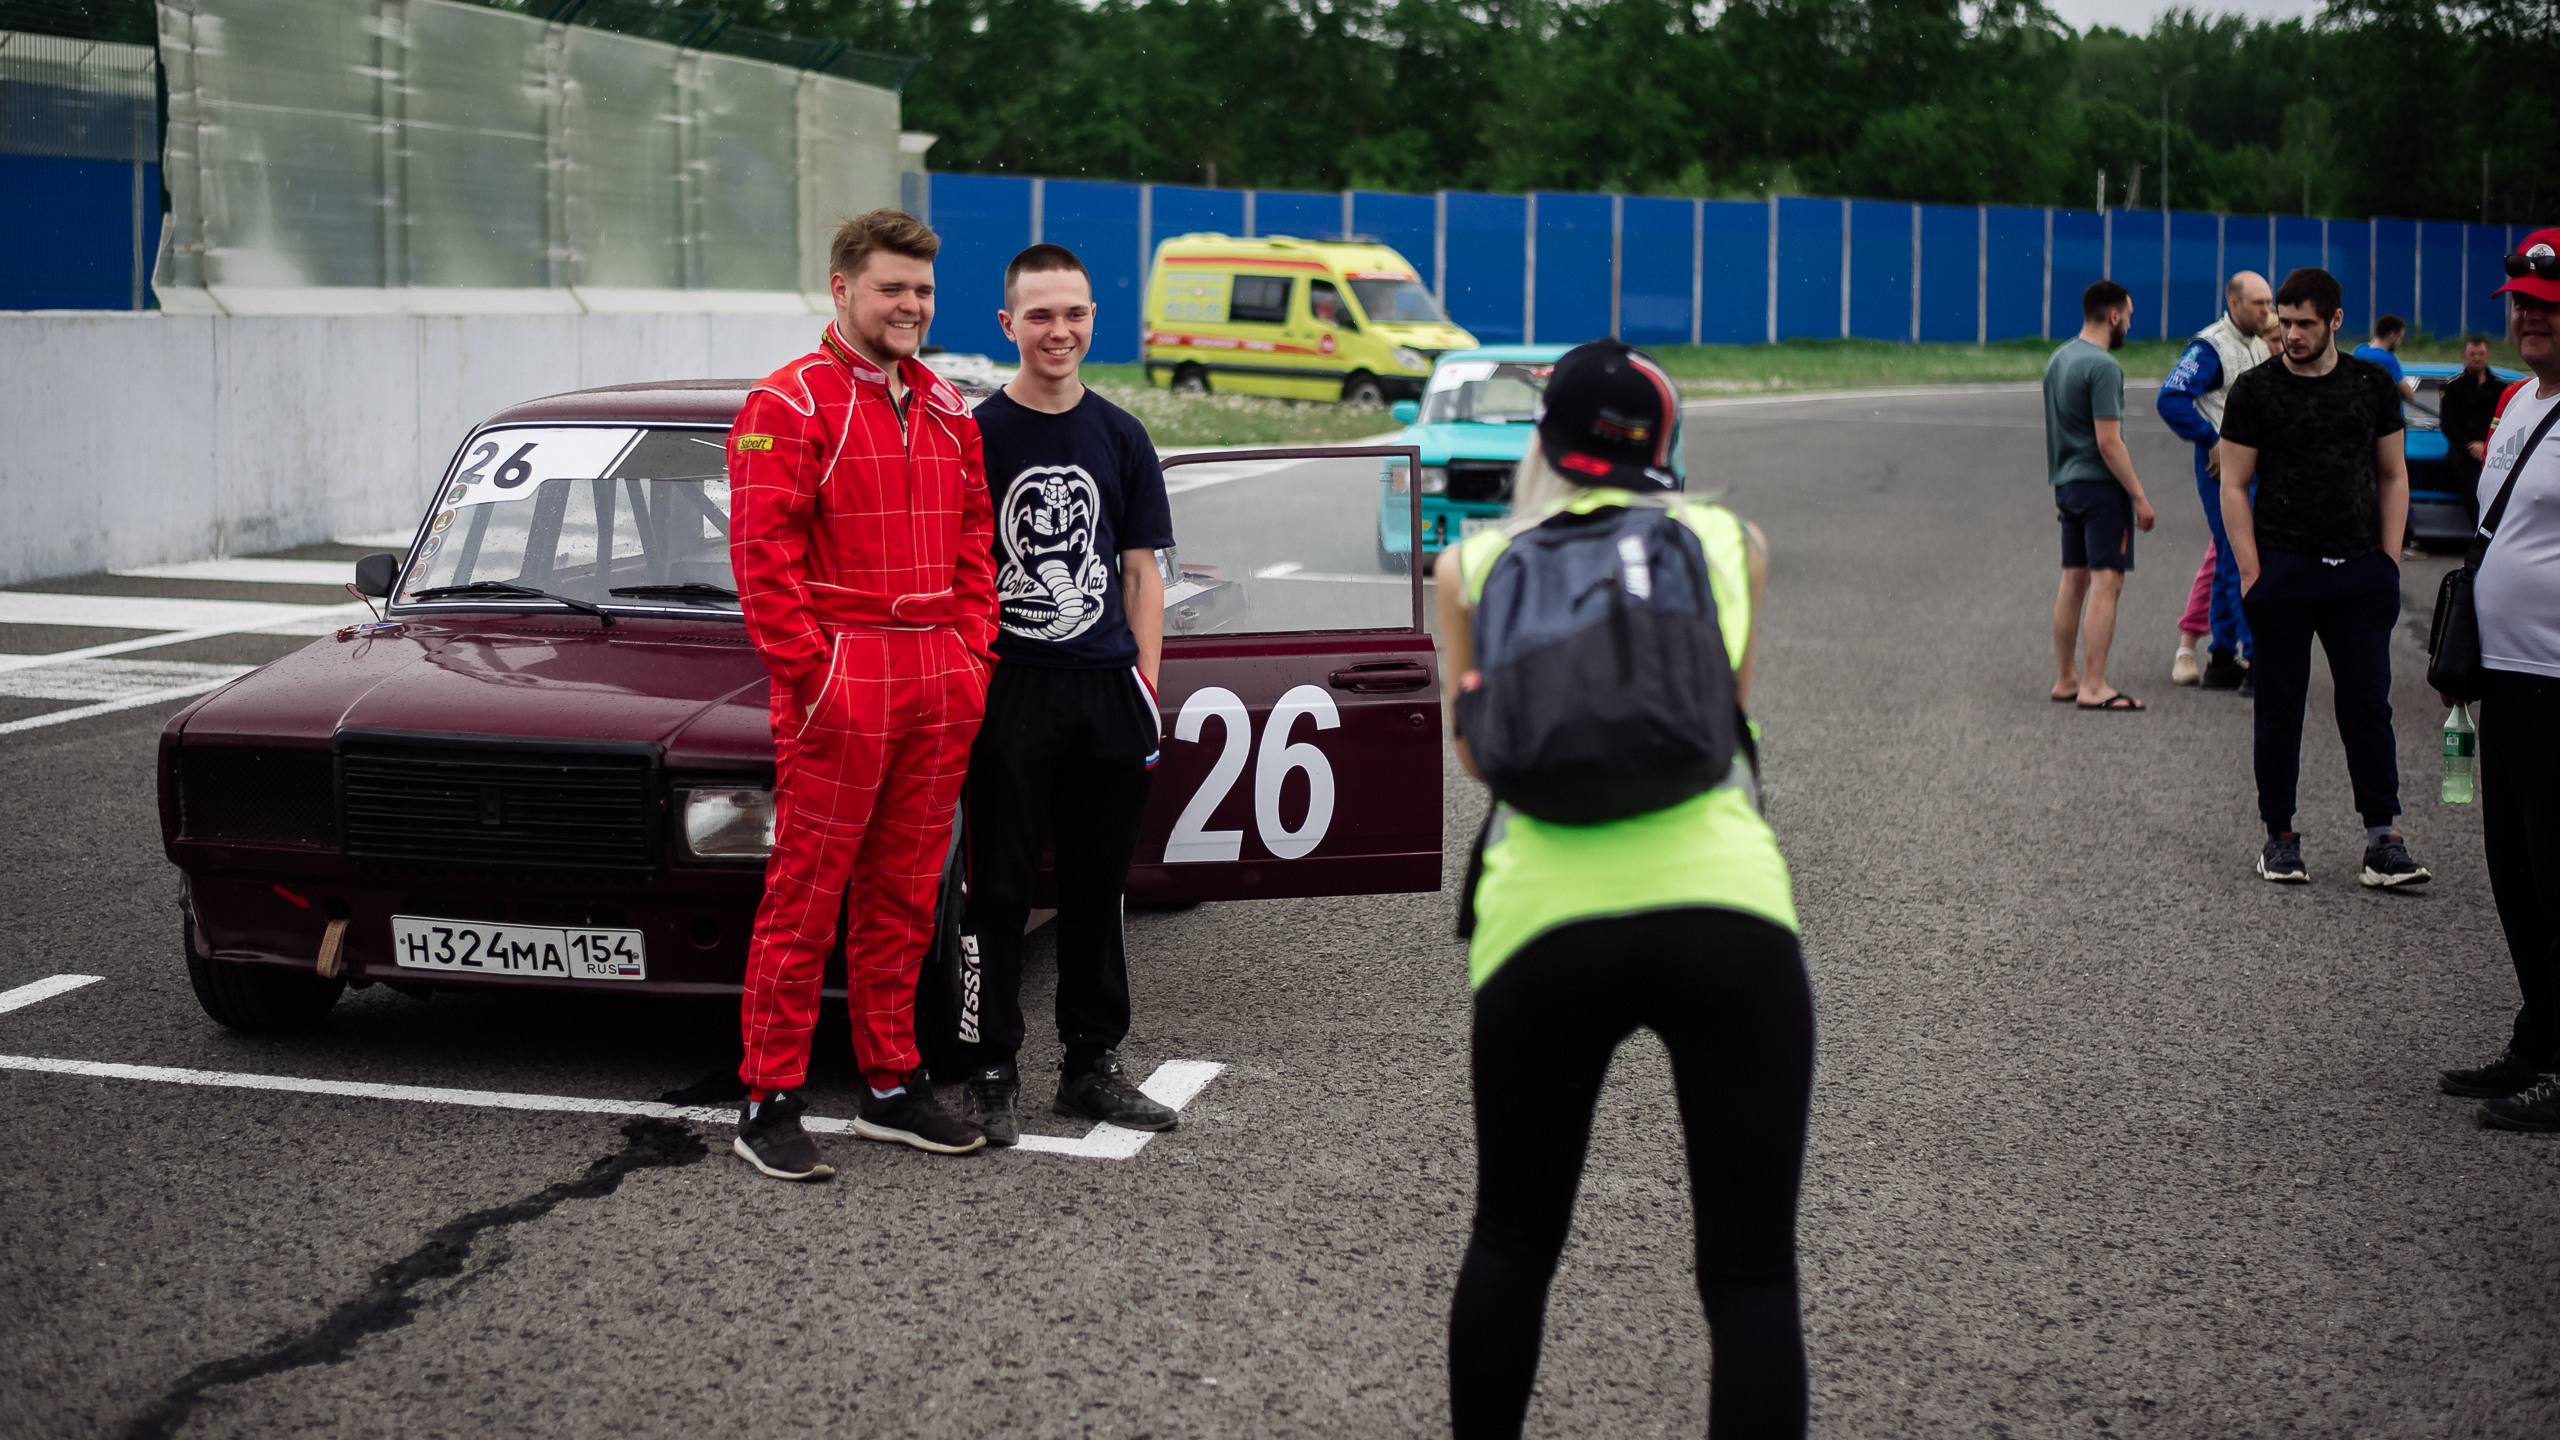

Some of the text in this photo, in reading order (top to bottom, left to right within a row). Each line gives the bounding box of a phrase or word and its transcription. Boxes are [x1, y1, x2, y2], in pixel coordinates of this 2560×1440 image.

[740, 437, 767, 450] Sabelt
[455, 441, 539, 489] 26
[2487, 453, 2516, 471] adid
[998, 556, 1105, 596] Cobra Kai
[1163, 684, 1341, 863] 26
[571, 934, 633, 964] 154
[587, 963, 617, 975] RUS
[959, 934, 982, 1043] RUSSIA
